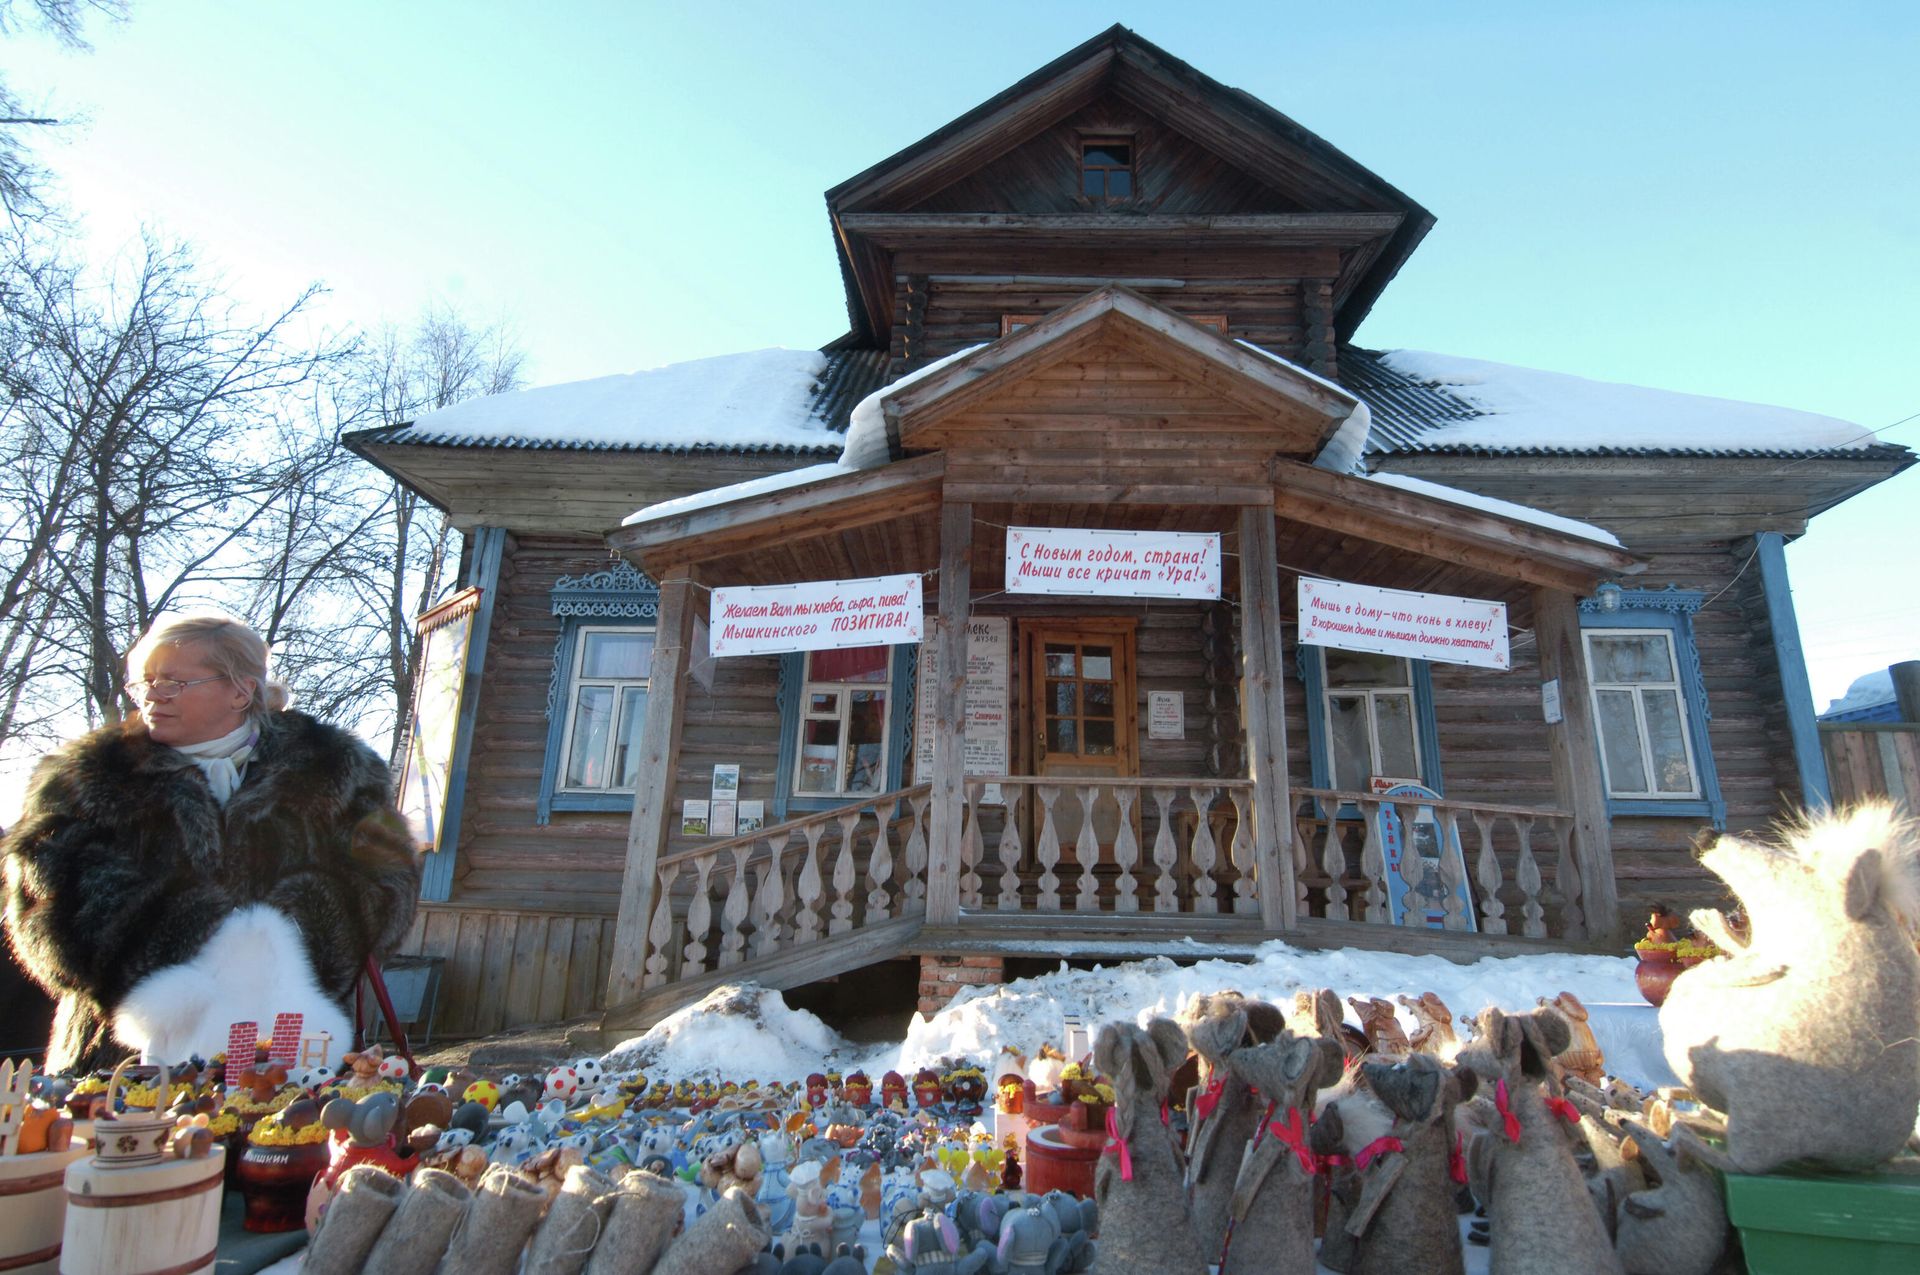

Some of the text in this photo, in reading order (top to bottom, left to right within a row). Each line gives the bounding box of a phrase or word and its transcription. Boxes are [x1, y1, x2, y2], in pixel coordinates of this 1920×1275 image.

[1020, 542, 1207, 567] С Новым годом, страна!
[1018, 560, 1207, 585] Мыши все кричат «Ура!»
[722, 590, 908, 618] Желаем Вам мы хлеба, сыра, пива!
[1310, 596, 1341, 613] Мышь
[1345, 604, 1352, 615] в
[1354, 602, 1383, 622] дому
[1391, 610, 1413, 623] что
[1416, 613, 1442, 626] конь
[1445, 618, 1453, 627] в
[1455, 619, 1493, 634] хлеву!
[722, 623, 818, 640] Мышкинского
[830, 611, 910, 633] ПОЗИТИВА!
[1311, 615, 1495, 651] В хорошем доме и мышам должно хватать!
